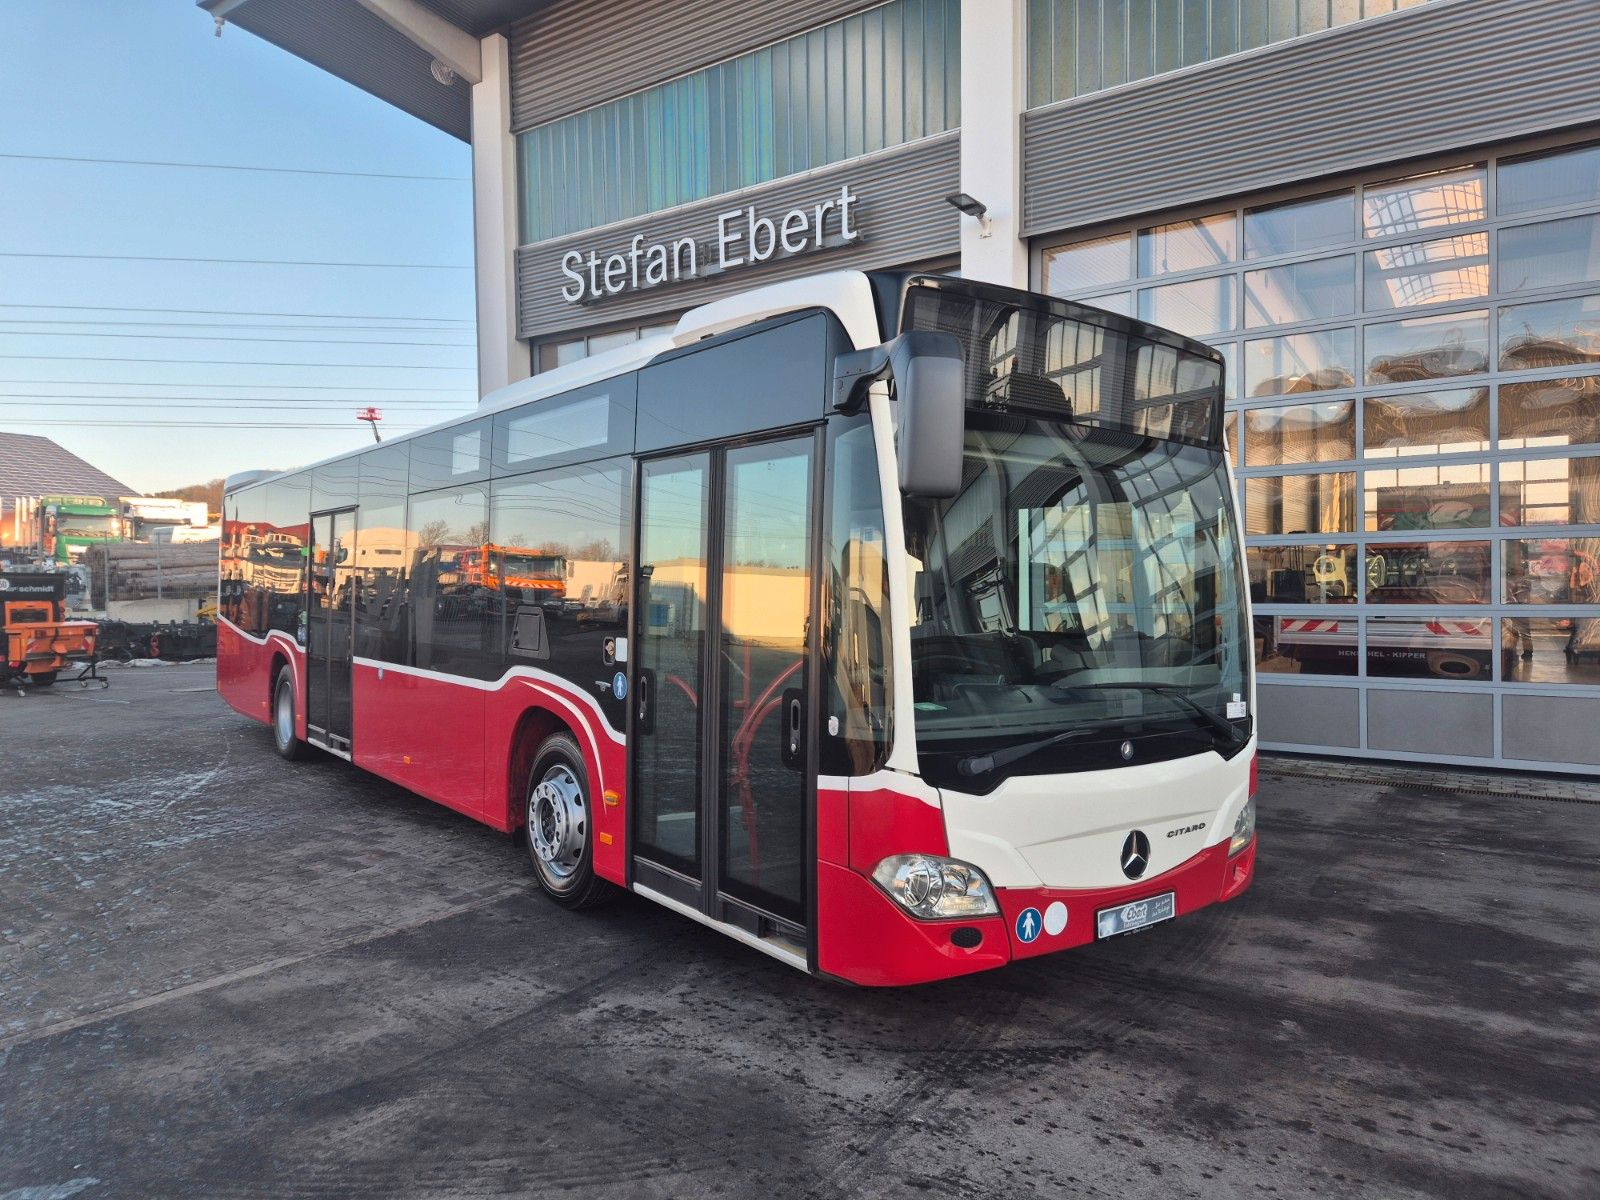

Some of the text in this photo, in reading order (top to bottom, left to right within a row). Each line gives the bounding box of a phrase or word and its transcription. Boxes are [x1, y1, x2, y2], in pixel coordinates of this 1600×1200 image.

[560, 185, 858, 302] Stefan Ebert
[1338, 650, 1385, 658] HENHEL
[1392, 651, 1426, 659] KIPPER
[1166, 822, 1206, 838] CITARO
